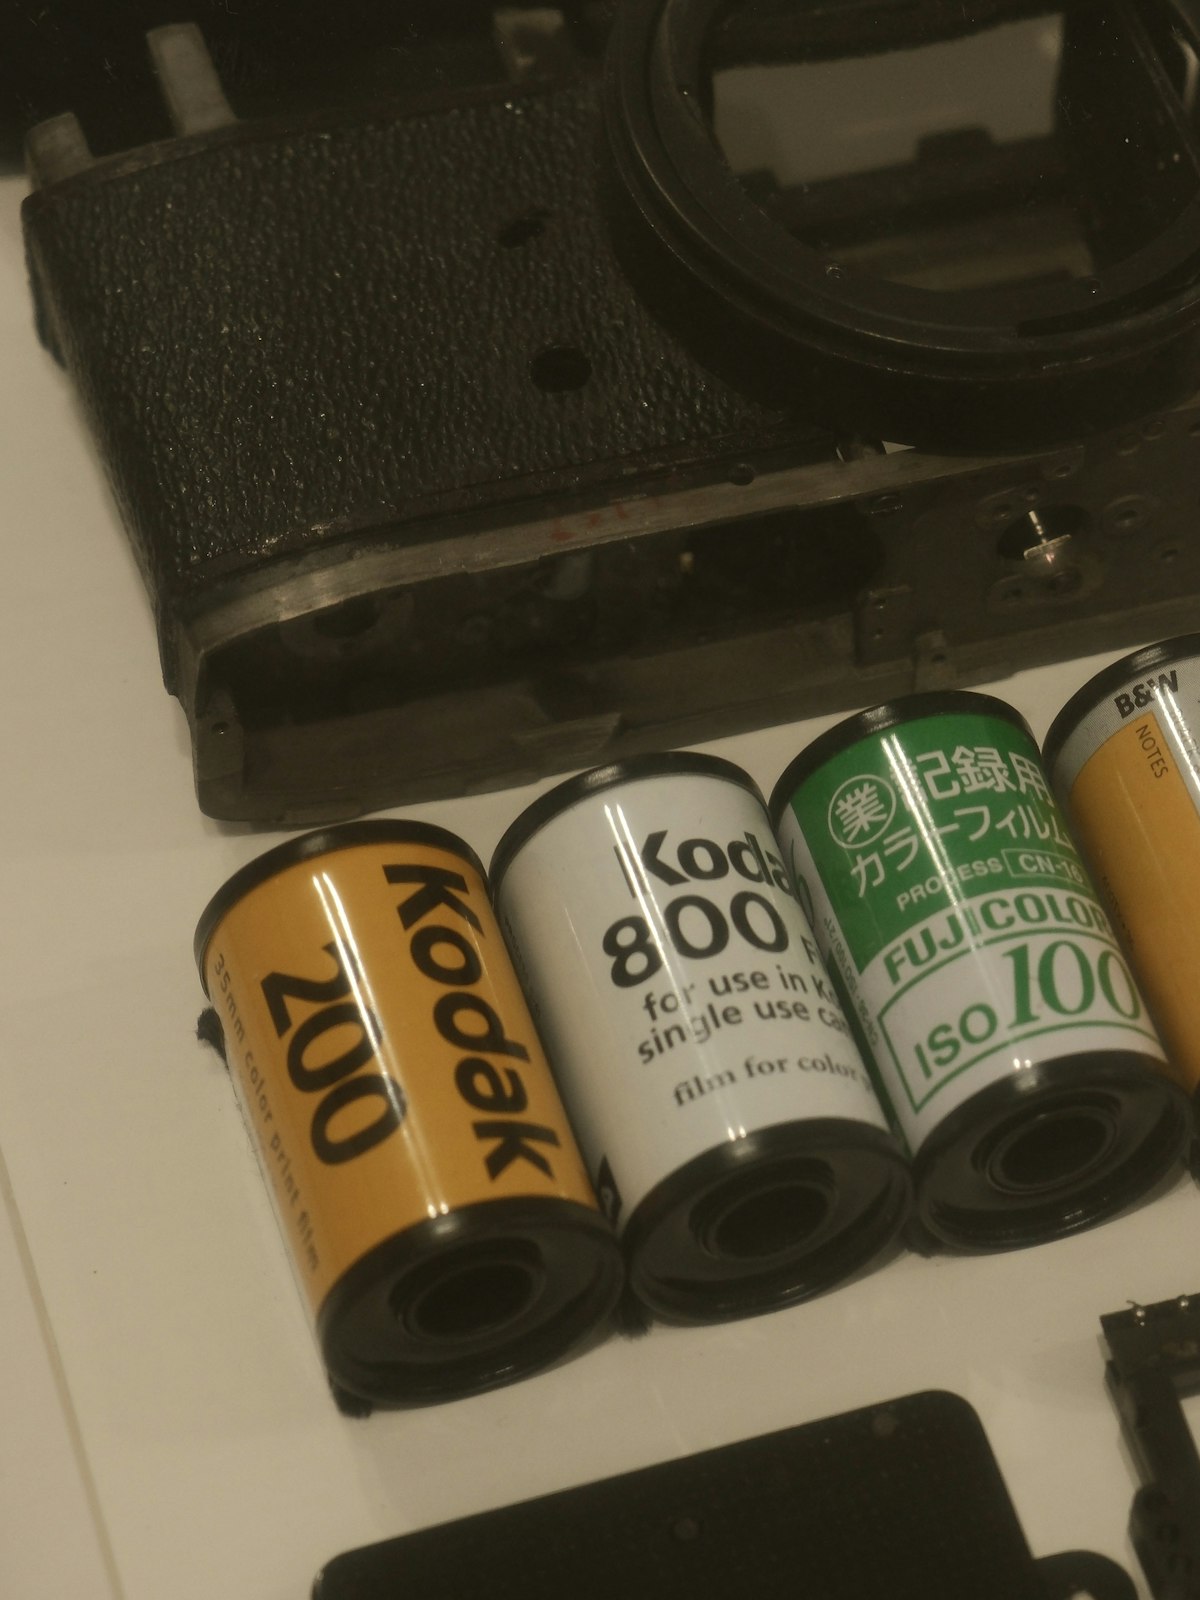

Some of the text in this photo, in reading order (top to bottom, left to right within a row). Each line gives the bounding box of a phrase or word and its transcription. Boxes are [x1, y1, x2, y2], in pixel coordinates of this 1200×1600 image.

[1114, 670, 1179, 718] B&W
[1136, 725, 1169, 779] NOTES
[832, 779, 890, 845] 業
[895, 853, 1084, 912] PROCESS CN-16
[602, 891, 789, 988] 800
[382, 864, 561, 1182] Kodak
[644, 982, 695, 1022] for
[708, 970, 770, 997] use
[776, 965, 807, 995] in
[914, 940, 1141, 1079] ISO 100
[260, 939, 407, 1167] 200
[638, 999, 810, 1065] single use
[673, 1053, 857, 1107] film for color
[213, 953, 320, 1274] 35mm color print film
